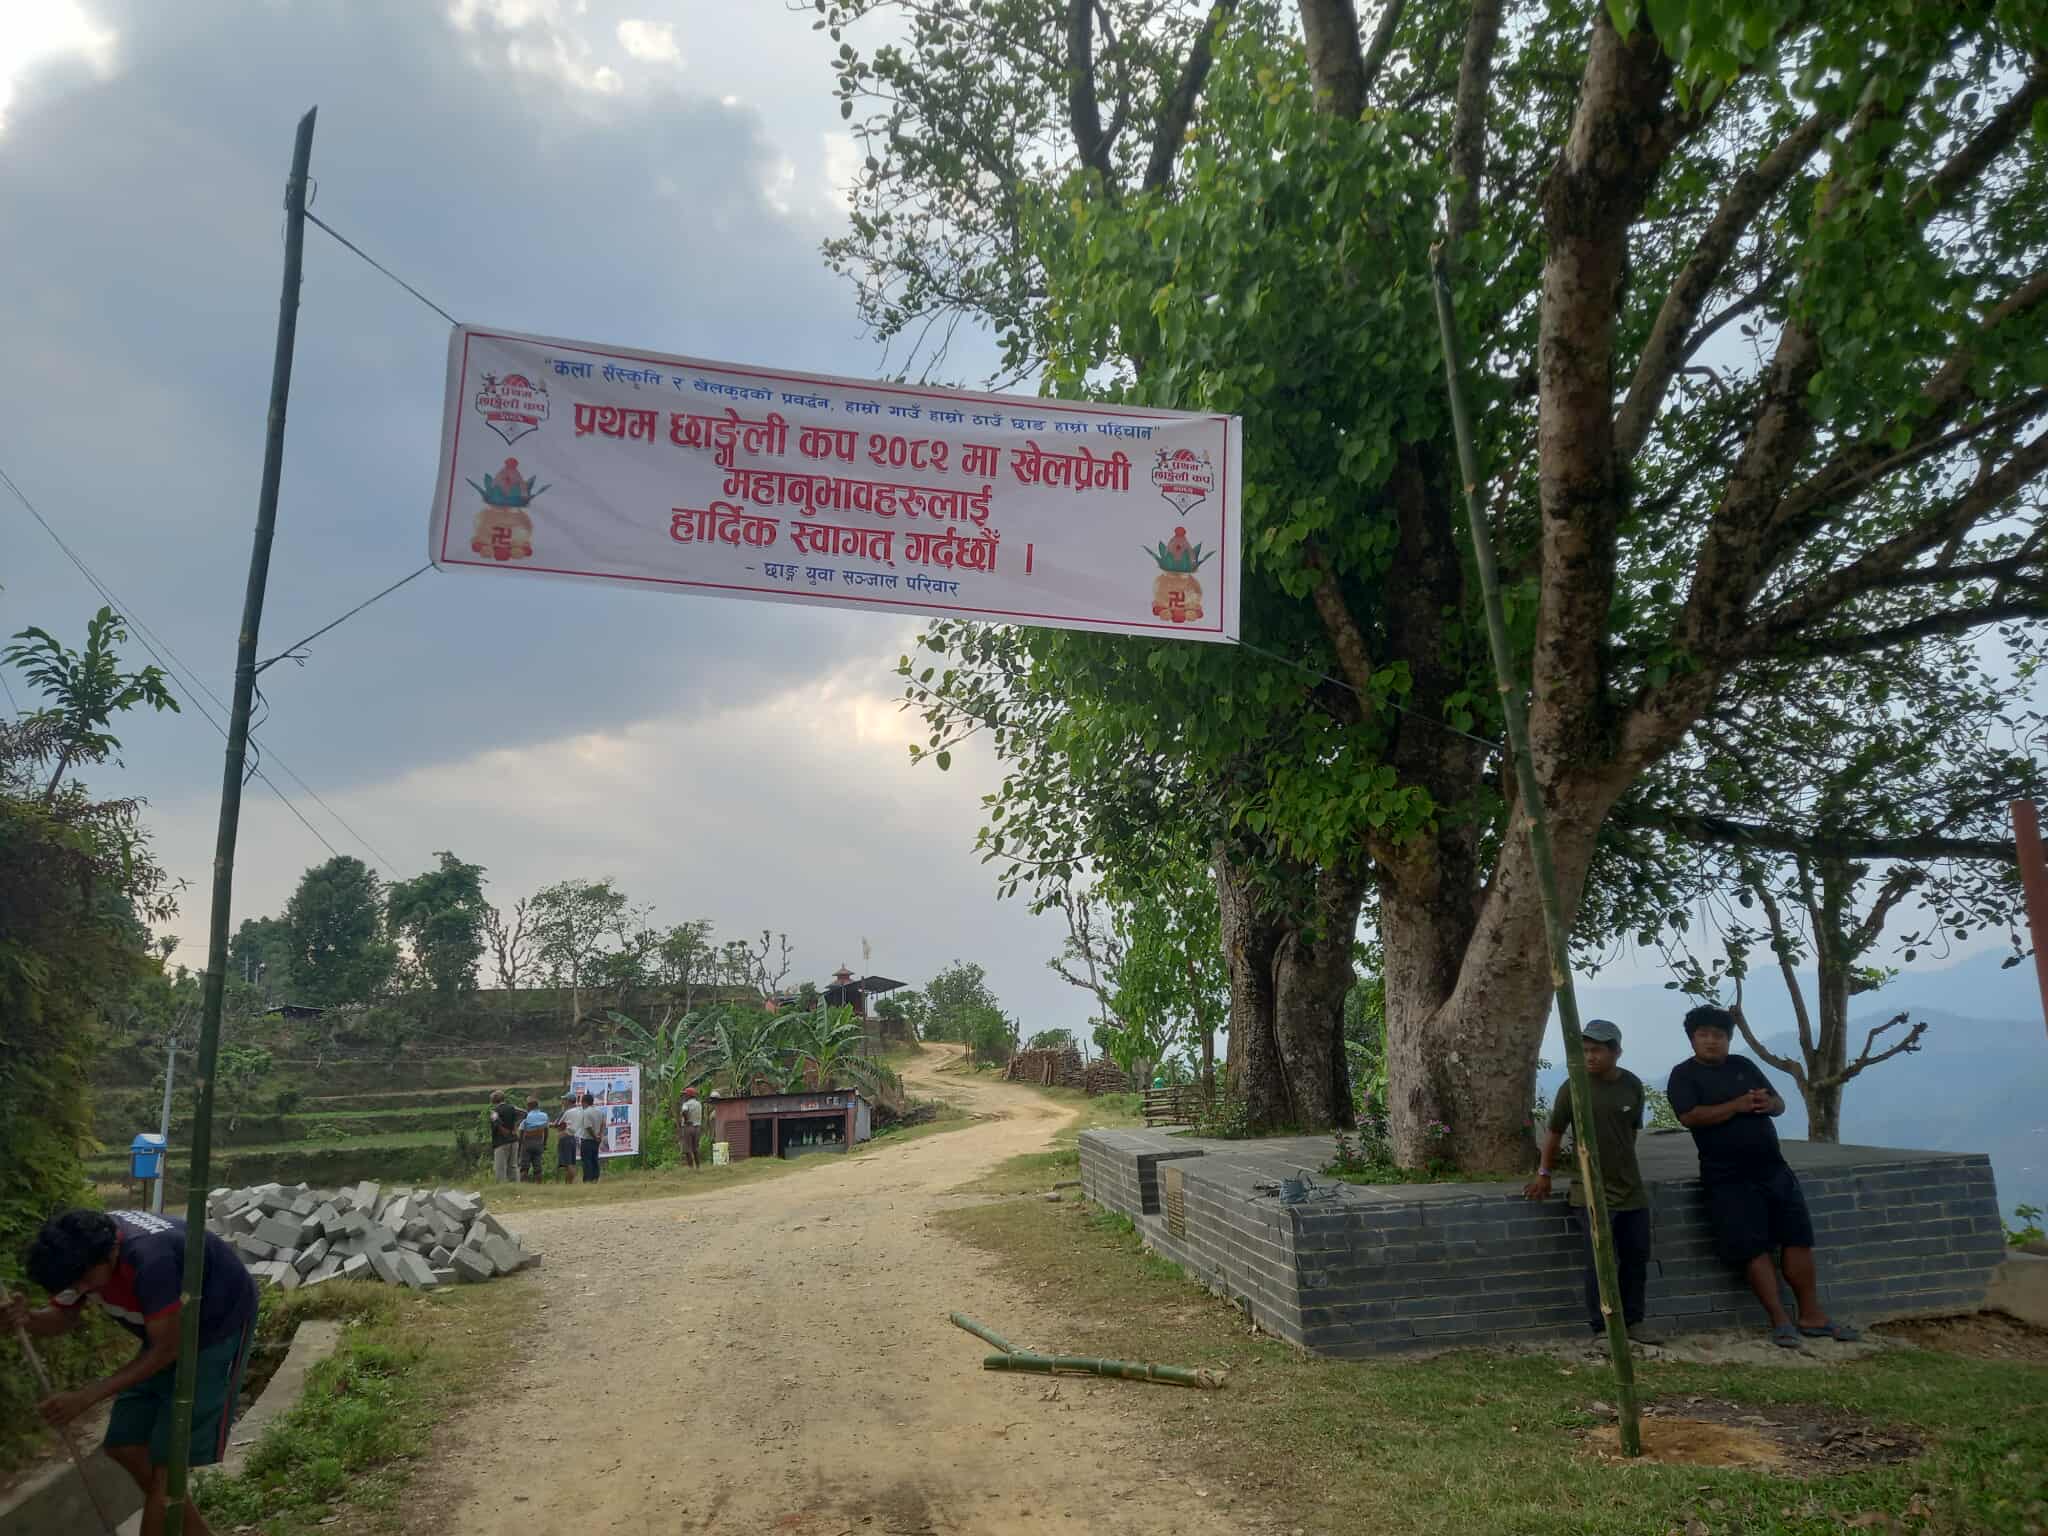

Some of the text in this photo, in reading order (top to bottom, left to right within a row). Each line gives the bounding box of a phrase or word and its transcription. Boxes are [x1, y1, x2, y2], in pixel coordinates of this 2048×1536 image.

[672, 377, 684, 391] र
[574, 403, 659, 443] प्रथम
[799, 426, 858, 462] कप
[868, 433, 949, 472] २०८२
[962, 444, 1001, 478] मा
[1010, 440, 1132, 491] खेलप्रेमी
[671, 501, 780, 547] हार्दिक
[806, 566, 835, 587] युवा
[906, 573, 962, 597] परिवार
